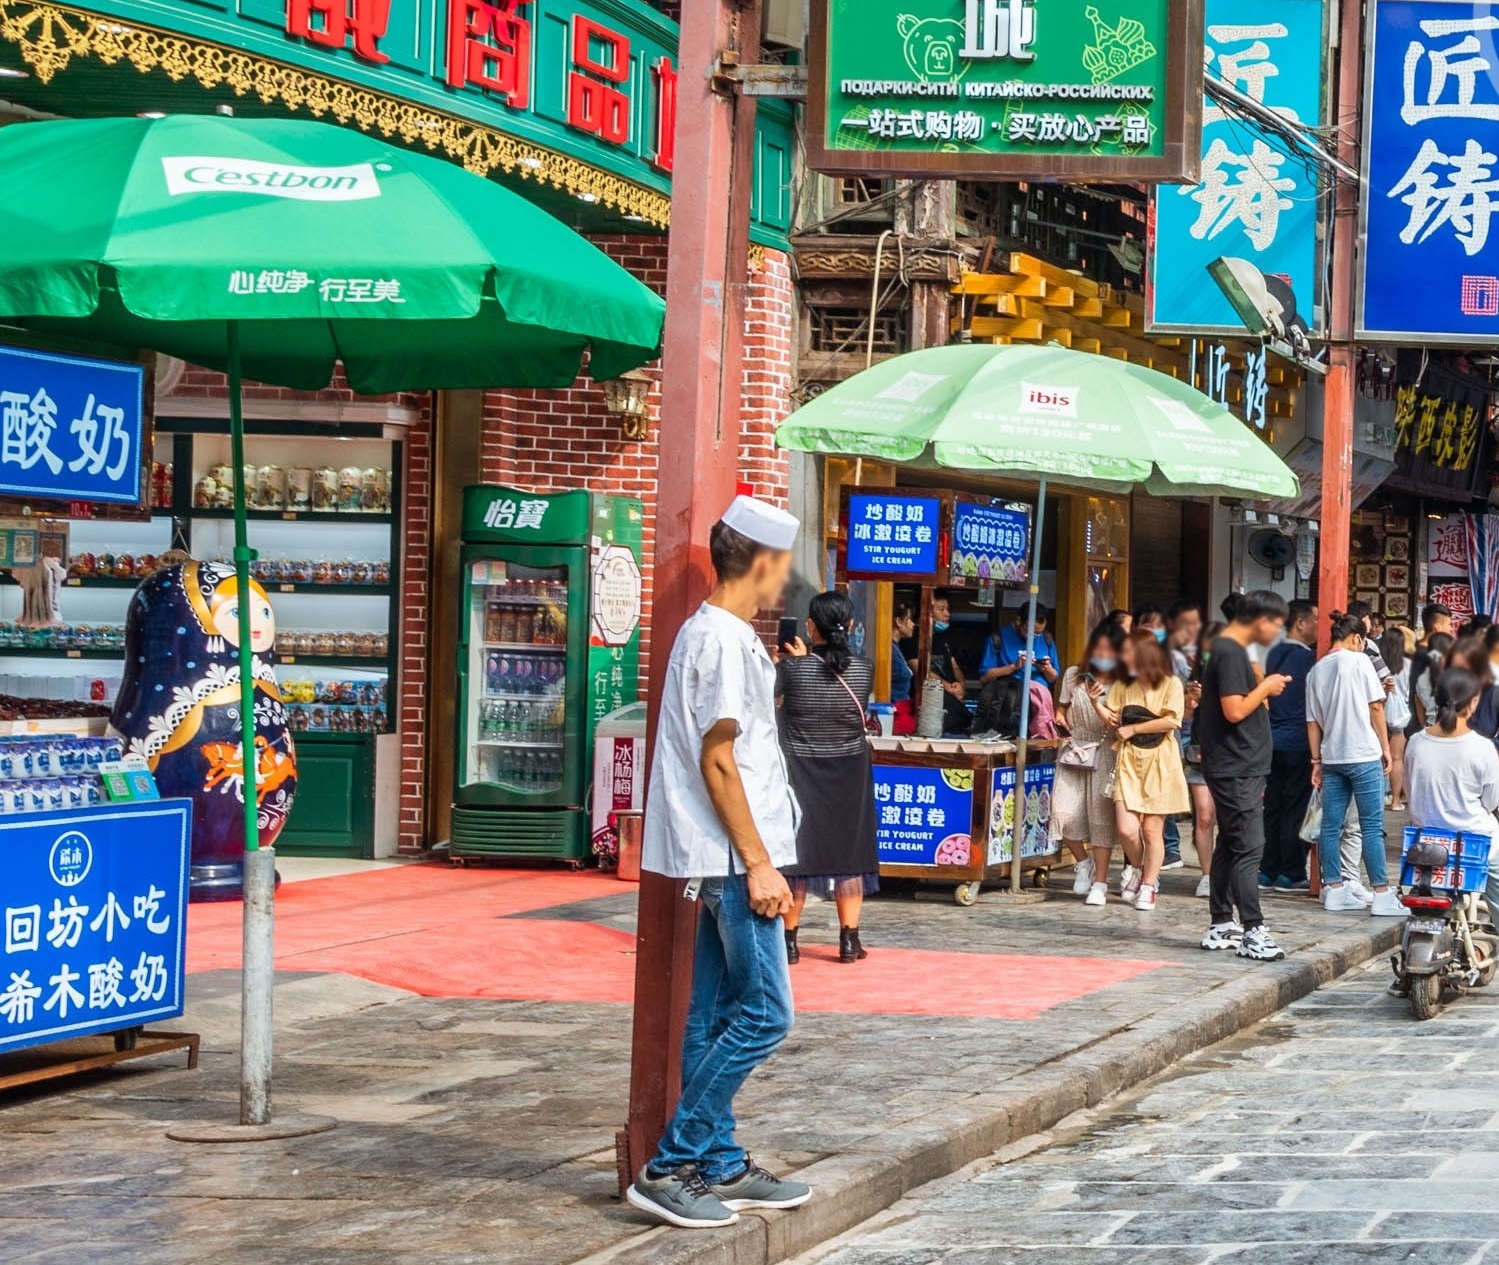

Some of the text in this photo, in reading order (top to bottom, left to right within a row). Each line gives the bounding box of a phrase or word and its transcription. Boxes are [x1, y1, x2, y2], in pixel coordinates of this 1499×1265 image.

[228, 269, 406, 303] 心纯净 行至美
[1029, 390, 1070, 408] ibis
[0, 386, 131, 482] 酸奶
[483, 498, 550, 530] 怡寶
[865, 502, 924, 523] 炒酸奶
[854, 523, 932, 543] 冰激凌卷
[863, 545, 882, 554] STIR
[886, 557, 913, 565] CREAM
[895, 842, 924, 851] CREAM
[4, 884, 171, 953] 回坊小吃
[0, 952, 169, 1025] 希木酸奶
